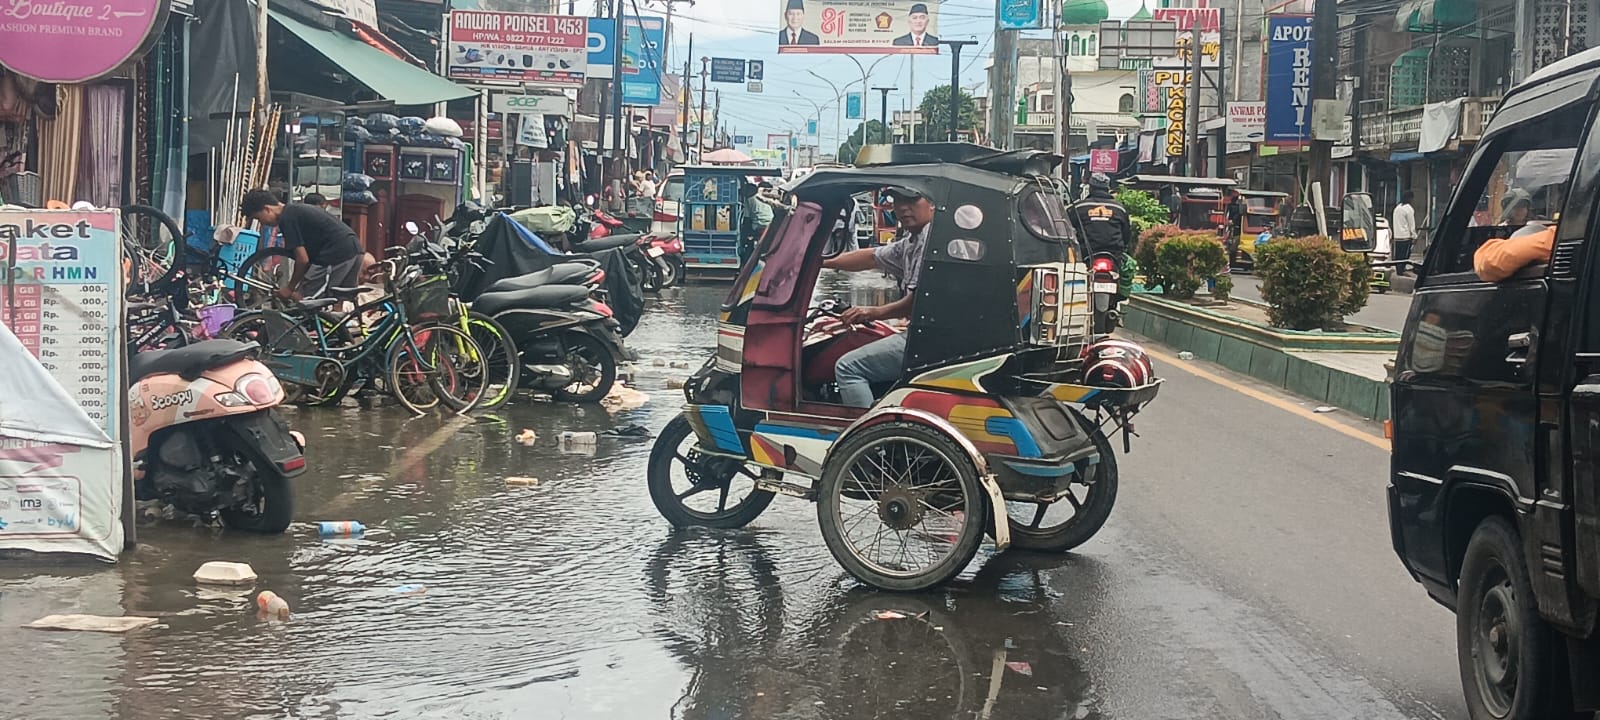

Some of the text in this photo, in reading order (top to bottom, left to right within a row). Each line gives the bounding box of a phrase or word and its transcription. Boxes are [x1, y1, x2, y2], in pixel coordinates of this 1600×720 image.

[4, 0, 111, 21] Boutique 2
[39, 25, 86, 35] PREMIUM
[88, 27, 122, 37] BRAND
[455, 12, 583, 36] ANWAR PONSEL 1453
[751, 62, 762, 78] P
[1291, 48, 1312, 126] RENI
[506, 96, 543, 107] acer
[1167, 87, 1184, 156] KACANG
[151, 389, 193, 411] Scoopy
